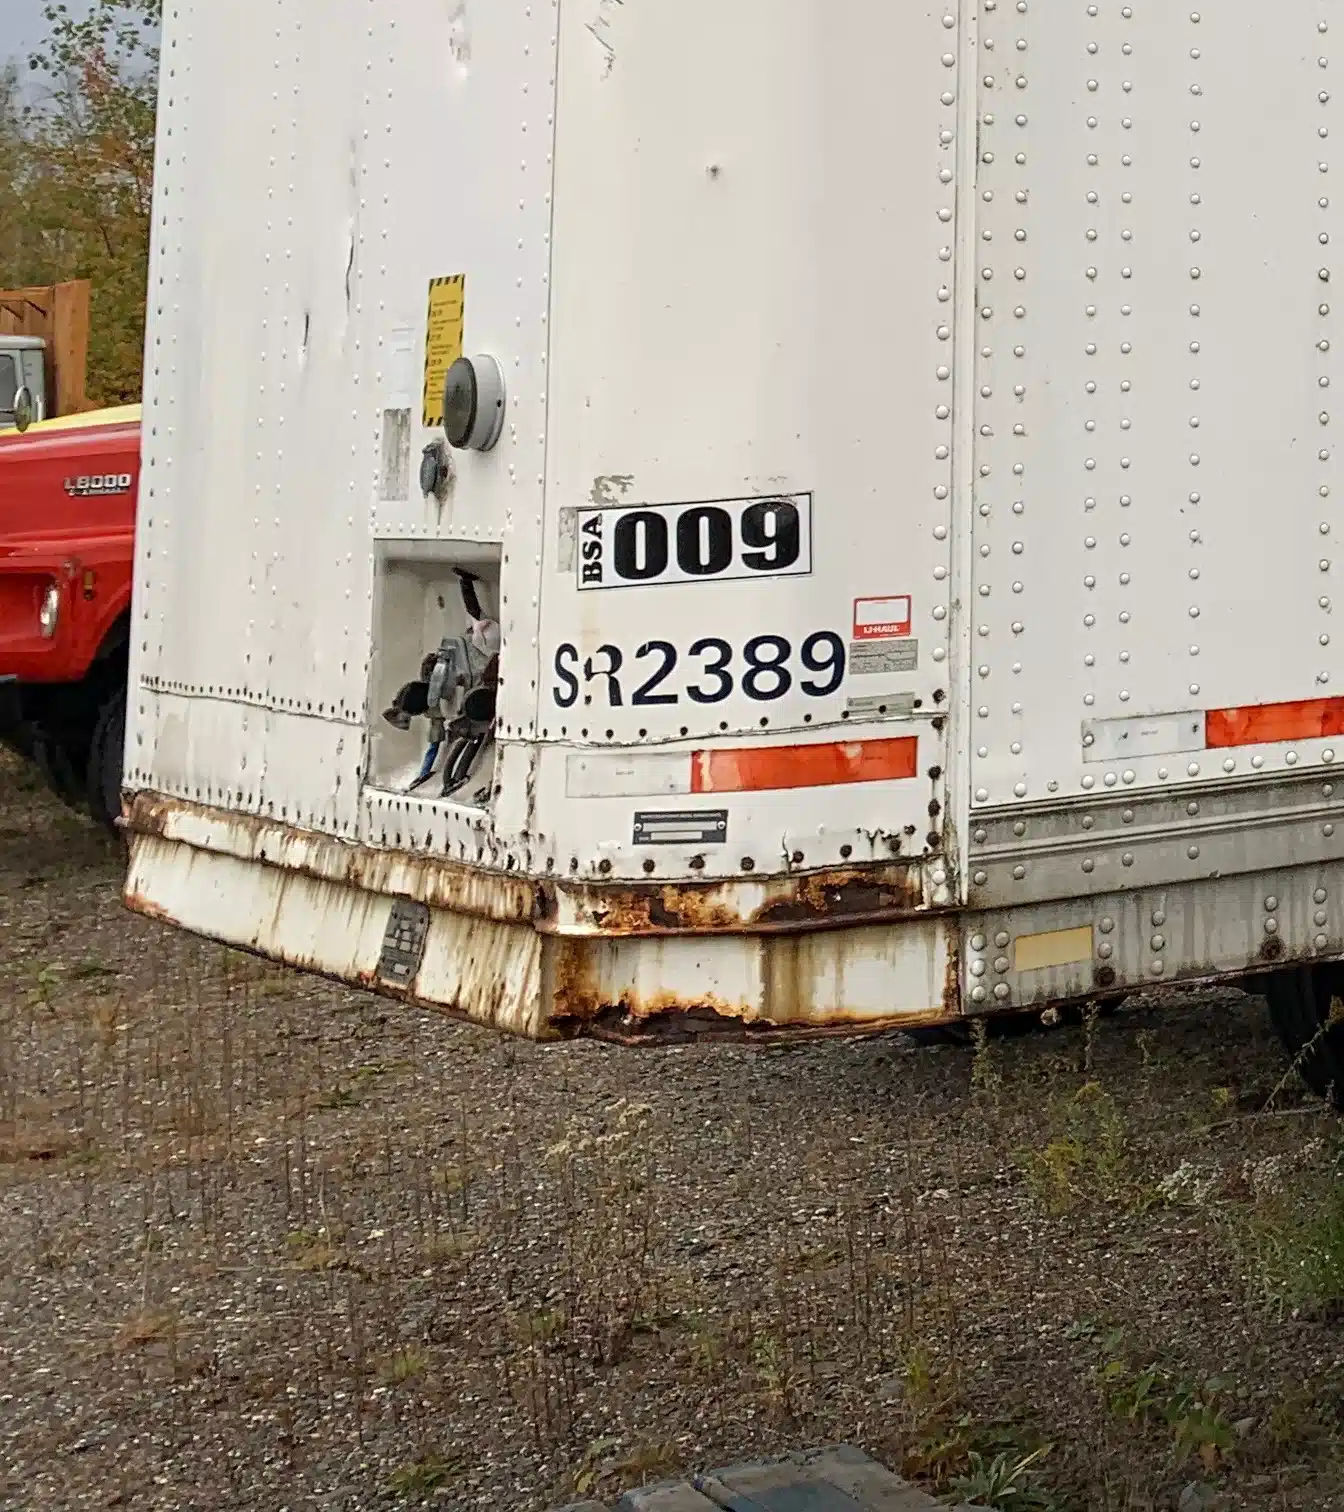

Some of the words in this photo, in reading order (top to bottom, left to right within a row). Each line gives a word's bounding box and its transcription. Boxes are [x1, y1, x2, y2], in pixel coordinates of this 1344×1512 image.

[582, 513, 603, 584] BSA
[614, 501, 800, 580] 009
[863, 625, 900, 634] U-HAUL
